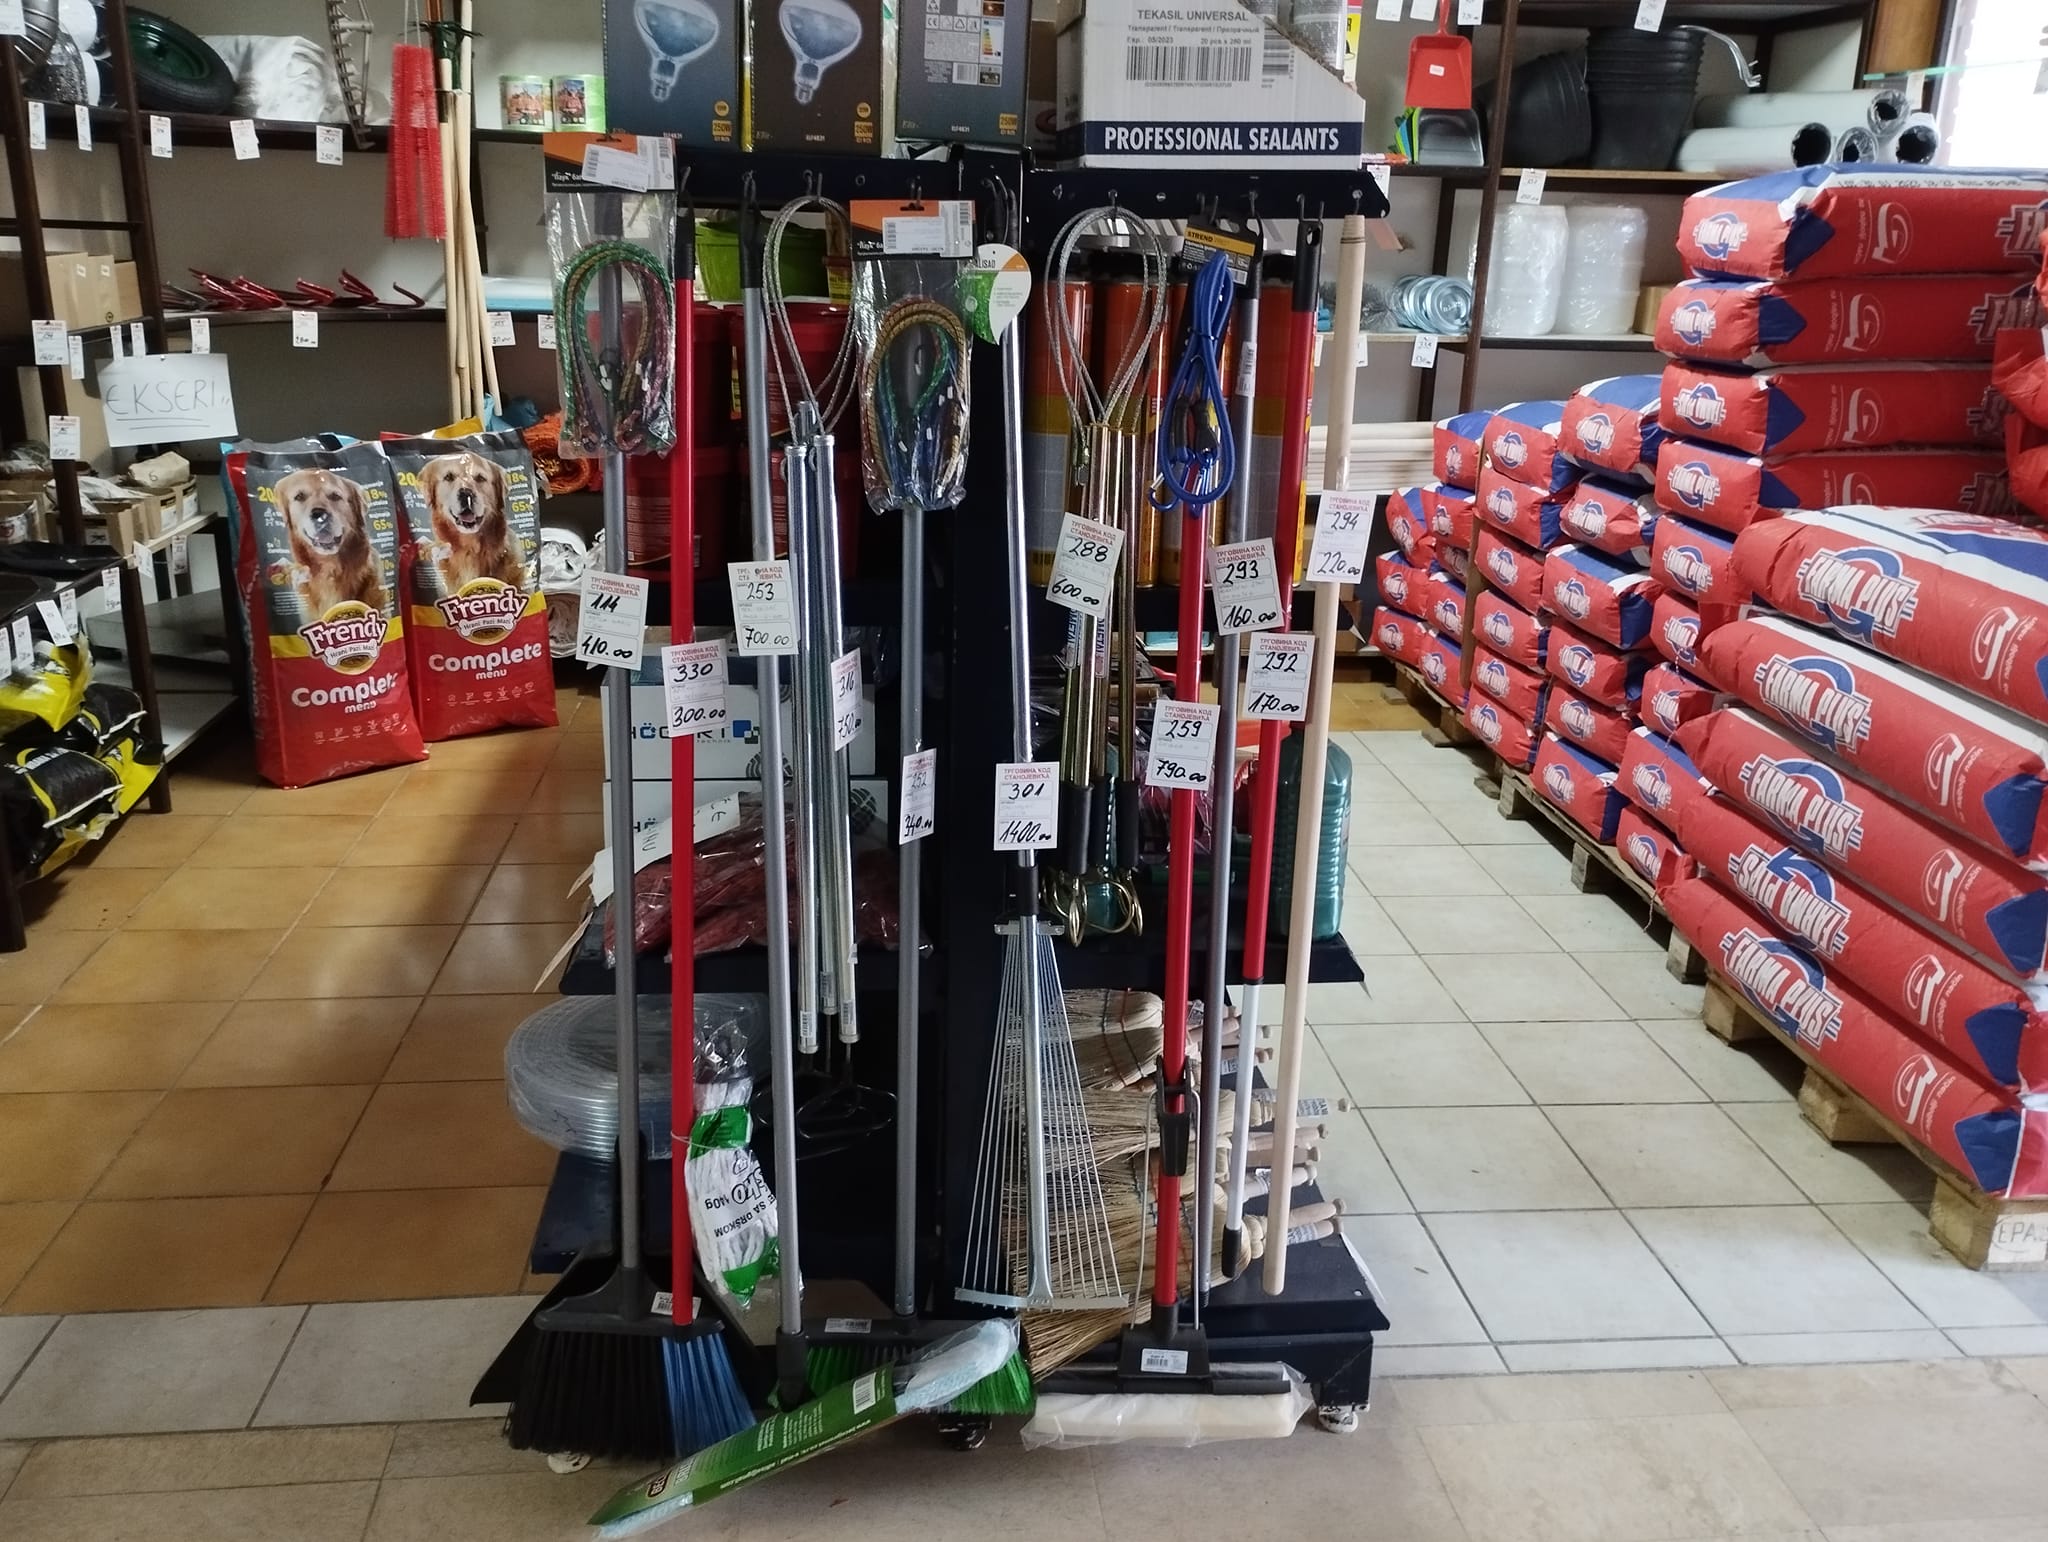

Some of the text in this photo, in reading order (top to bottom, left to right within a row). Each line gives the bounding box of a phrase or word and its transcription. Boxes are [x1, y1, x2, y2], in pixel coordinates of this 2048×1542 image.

[1137, 10, 1249, 21] TEKASIL UNIVERSAL
[1104, 127, 1339, 151] PROFESSIONAL SEALANTS
[1187, 231, 1214, 243] STREND
[973, 259, 996, 269] ALISAD
[512, 502, 533, 512] 65%
[373, 519, 393, 530] 65%
[1071, 521, 1116, 540] ТРГОВИНА КОД
[1331, 512, 1359, 530] 294
[1070, 528, 1113, 547] СТАНОЈЕВИЋА
[1069, 538, 1108, 562] 288
[1216, 545, 1266, 558] ТРГОВИНА КОД
[1218, 552, 1265, 564] СТАНОЈЕВИЋА
[1223, 560, 1259, 585] 293
[1317, 552, 1360, 575] 220.00
[591, 577, 624, 588] ТРГОВИНА
[591, 584, 638, 596] СТАНОЈЕВИЋА
[747, 582, 774, 601] 253
[1052, 578, 1100, 605] 600.00
[1806, 556, 1911, 628] FARMA PLUS
[440, 591, 527, 625] Frendy
[1223, 605, 1277, 628] 160.00
[304, 614, 388, 654] Frendy
[1260, 638, 1292, 646] ТРГОВИНА
[582, 635, 632, 658] 410.00
[671, 647, 704, 657] ТРГОВИНА
[1260, 645, 1305, 653] СТАНОЈЕВИЋА
[428, 643, 542, 671] Complete
[672, 652, 718, 663] СТАНОЈЕВИЋА
[1262, 652, 1298, 672] 292
[475, 669, 507, 680] menu
[673, 663, 713, 682] 330
[1165, 706, 1197, 714] ТРГОВИНА
[1248, 692, 1299, 714] 170.00
[1765, 662, 1865, 744] FARMA PLUS
[673, 706, 726, 727] 300.00
[1165, 712, 1210, 721] СТАНОЈЕВИЋА
[1165, 720, 1202, 739] 259
[1008, 783, 1045, 800] 301
[1750, 763, 1855, 852] FARMA PLUS
[1738, 854, 1842, 949] PLUS FARMA
[1729, 940, 1834, 1039] FARMA PLUS
[714, 1204, 767, 1238] SA DRŠKOM
